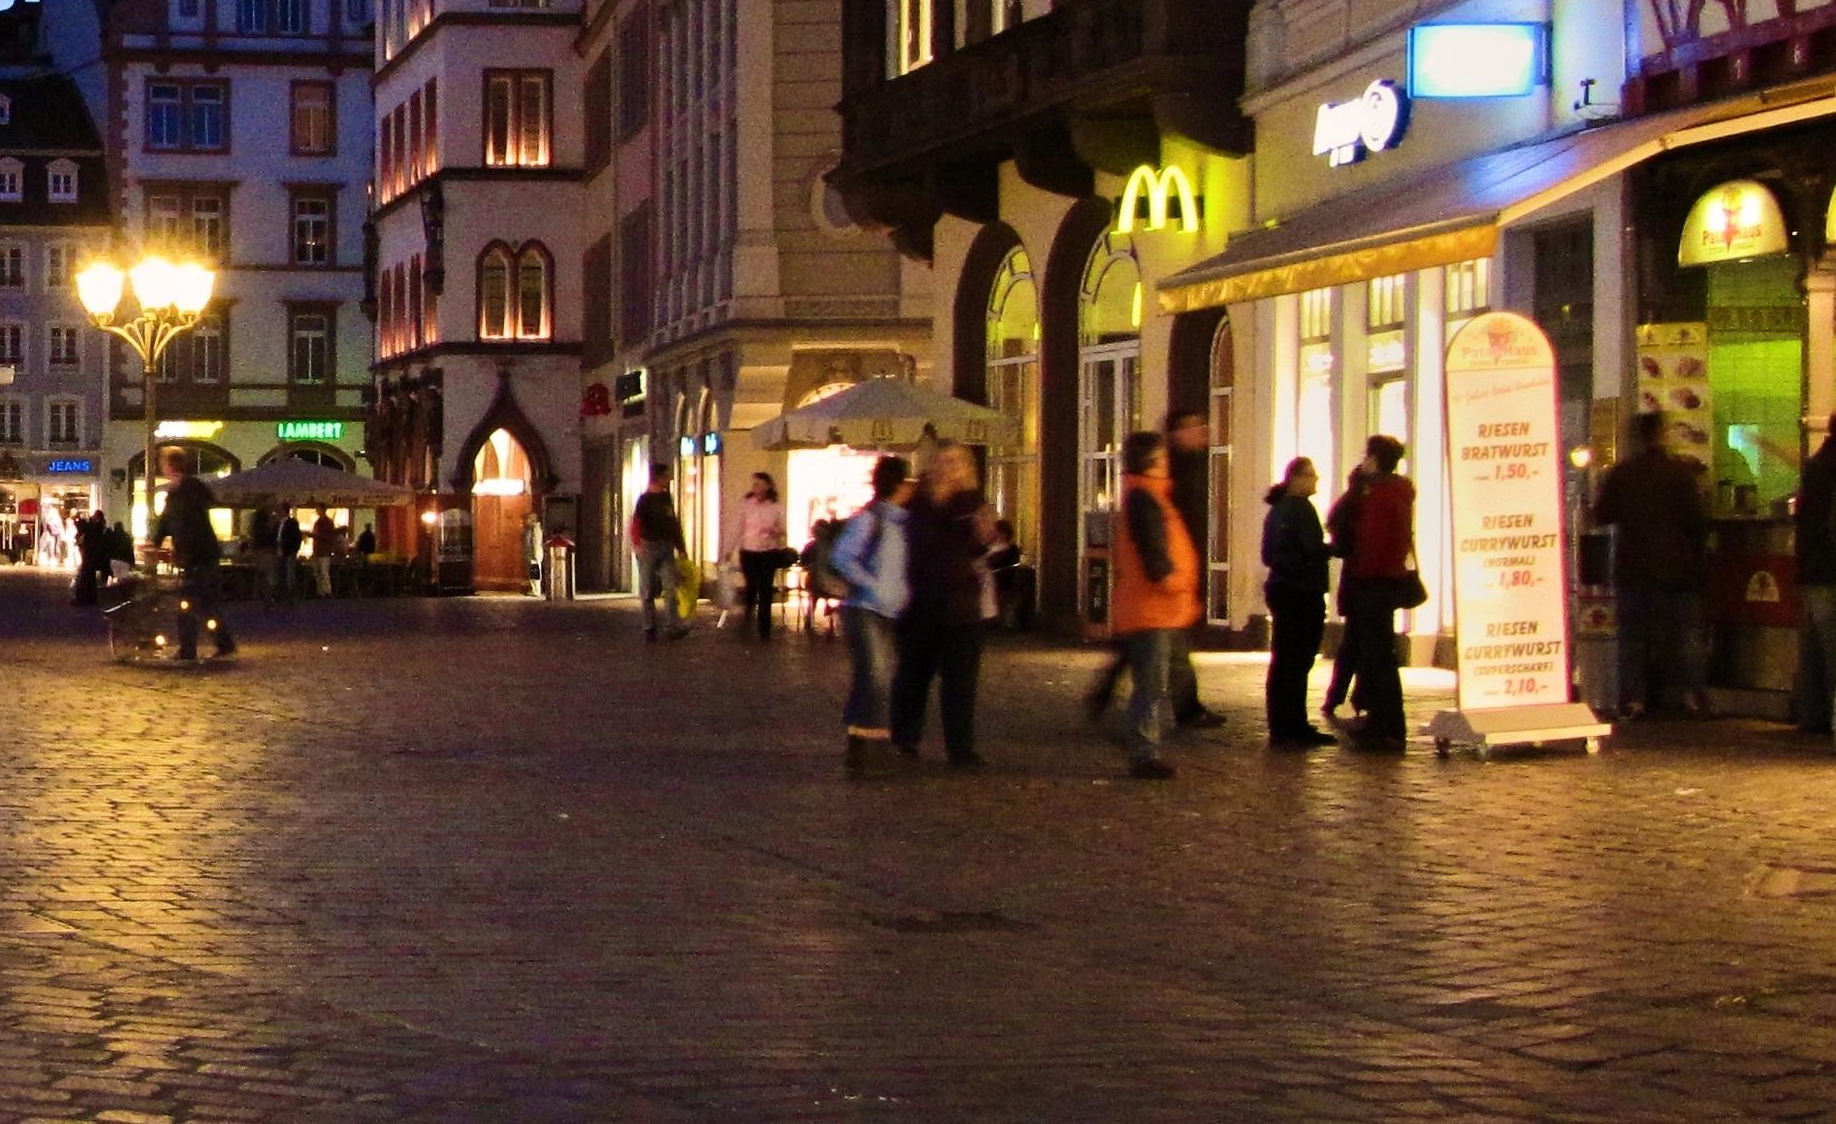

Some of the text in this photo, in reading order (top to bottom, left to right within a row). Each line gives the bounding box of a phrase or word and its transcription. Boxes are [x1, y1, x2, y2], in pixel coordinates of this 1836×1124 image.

[278, 422, 342, 439] LAMBERT
[1478, 422, 1531, 438] RIESEN
[1461, 442, 1548, 460] BRATWURST
[48, 460, 90, 471] JEANS
[1482, 514, 1534, 529] RIESEN
[1460, 534, 1557, 552] CURRYWURST
[1486, 621, 1538, 637] RIESEN
[1465, 641, 1562, 660] CURRYWURST
